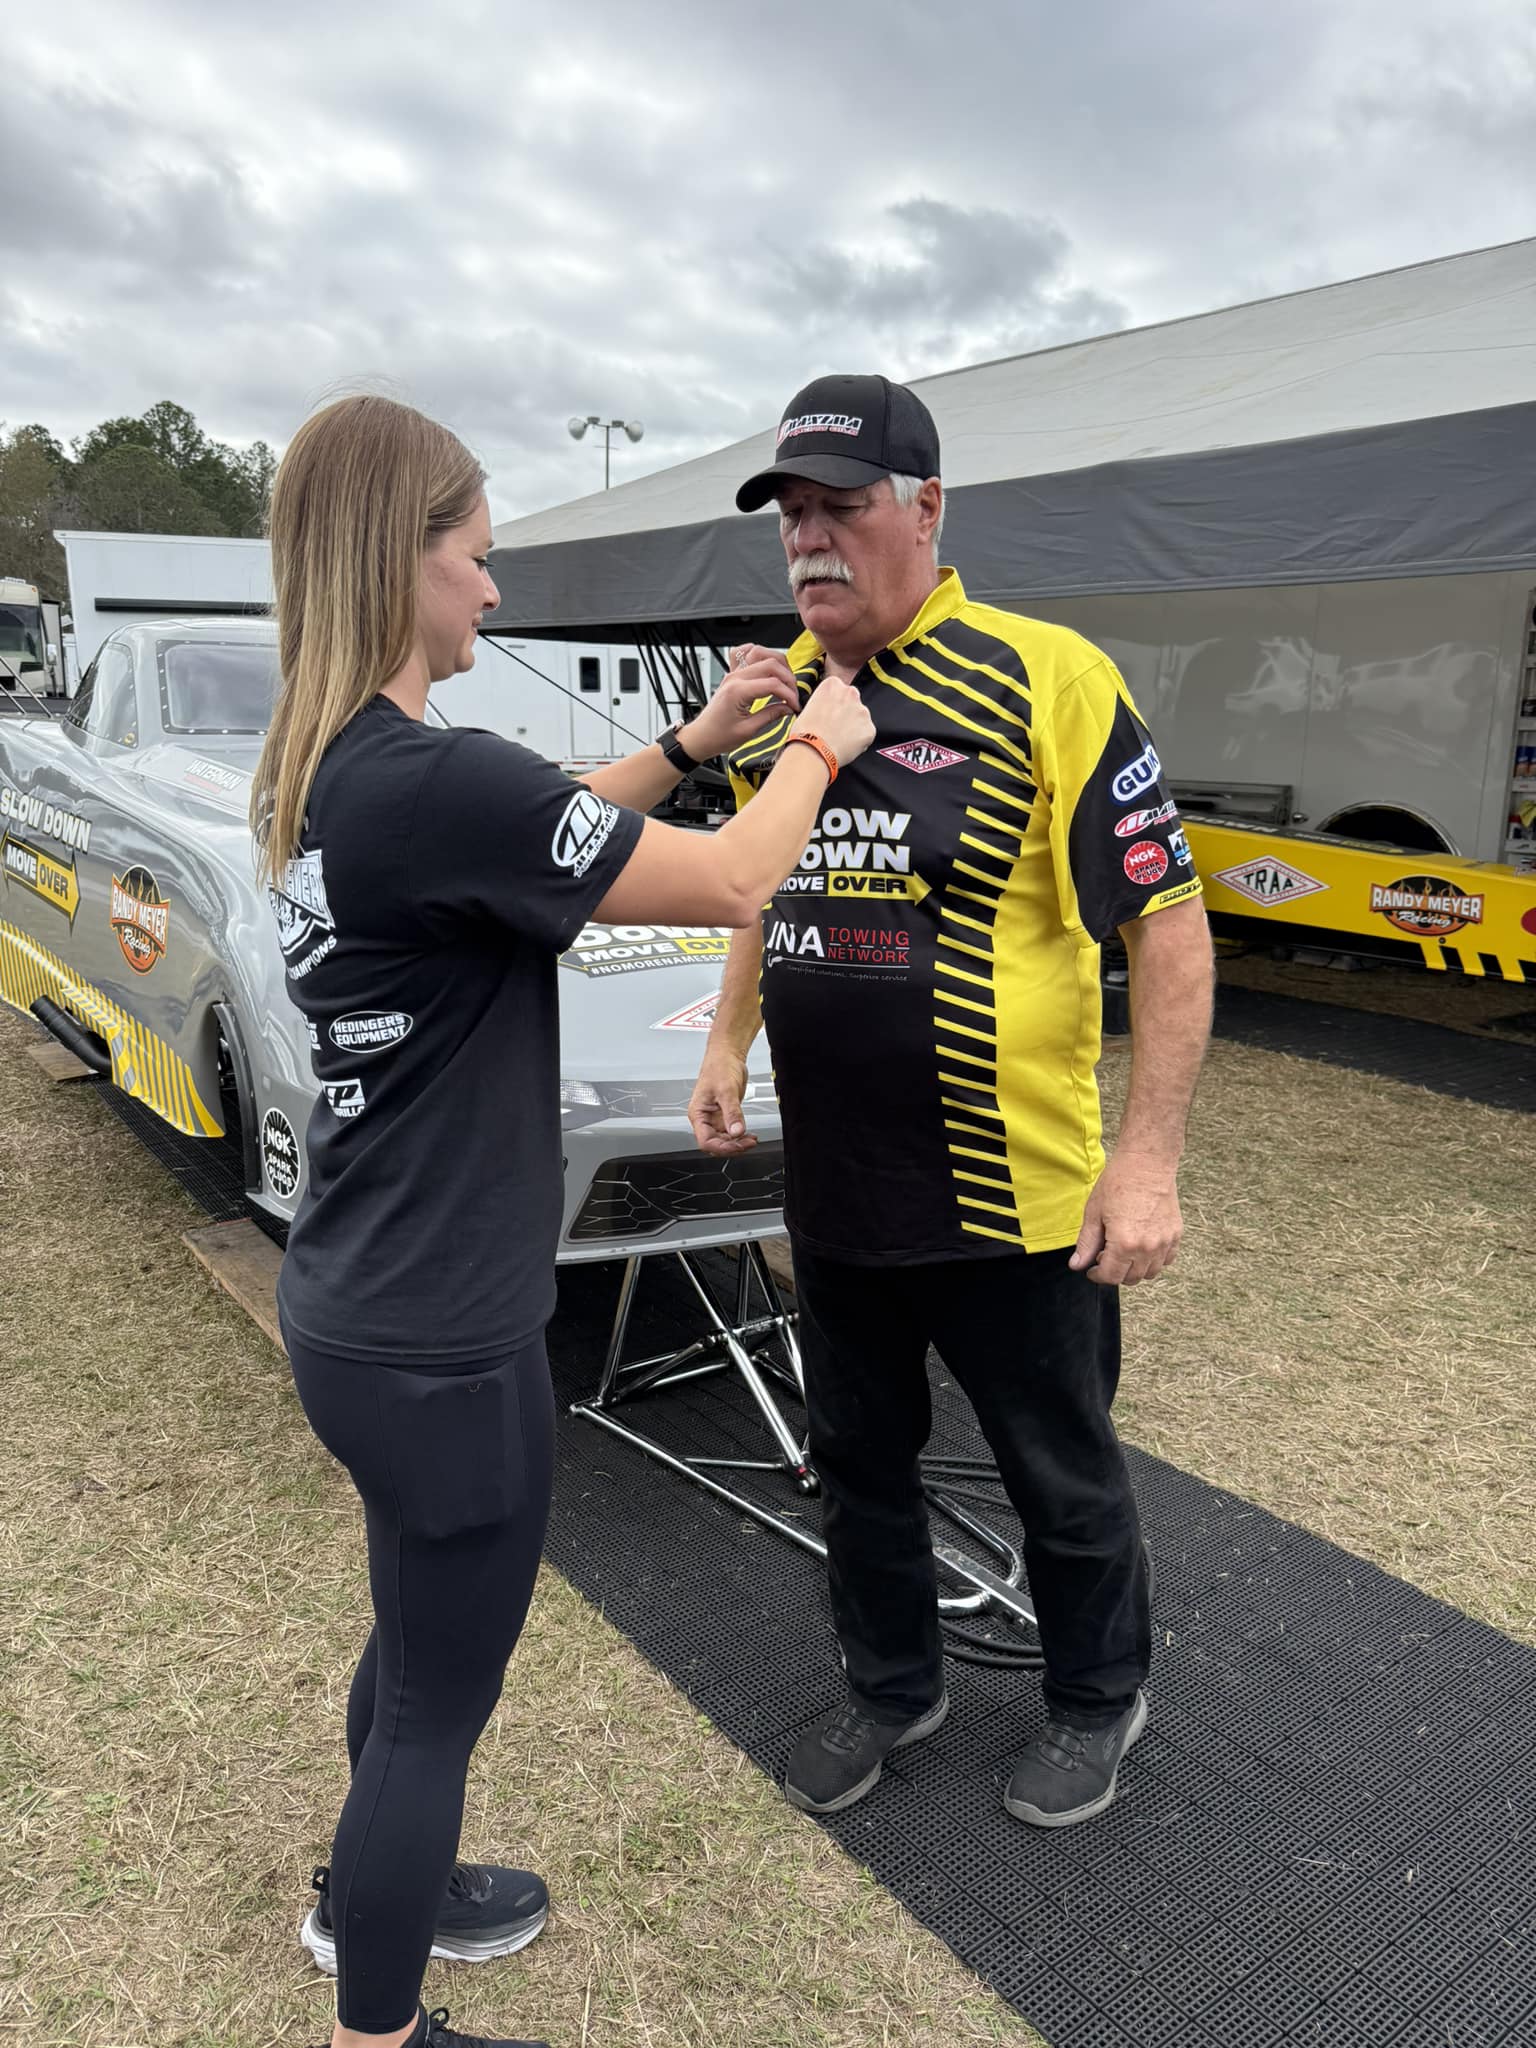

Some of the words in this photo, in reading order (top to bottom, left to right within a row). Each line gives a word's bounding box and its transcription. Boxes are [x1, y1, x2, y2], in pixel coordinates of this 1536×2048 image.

[0, 786, 43, 828] SLOW
[43, 803, 92, 854] DOWN
[810, 808, 912, 840] OW
[799, 841, 911, 873] OWN
[1129, 847, 1158, 867] NGK
[1135, 861, 1161, 875] SPARK
[7, 844, 37, 881] MOVE
[39, 863, 68, 900] OVER
[1136, 867, 1163, 880] PLUGS
[1243, 869, 1294, 895] TRAA
[833, 875, 907, 894] OVER
[1372, 886, 1424, 908] RANDY
[1428, 895, 1481, 919] MEYER
[112, 884, 138, 921] RANDY
[138, 903, 167, 946] MEYER
[1398, 911, 1453, 929] Racing
[124, 928, 151, 960] Racing
[828, 927, 909, 946] TOWING
[578, 942, 678, 963] MOVE
[686, 940, 729, 951] OV
[827, 947, 909, 963] NETWORK
[591, 953, 729, 976] #NOMORENAMESON
[333, 1014, 406, 1033] HEDINGERS
[335, 1025, 406, 1047] EQUIPMENT
[267, 1126, 291, 1157] NGK
[268, 1152, 292, 1172] SPARK
[269, 1164, 293, 1187] PLUGS
